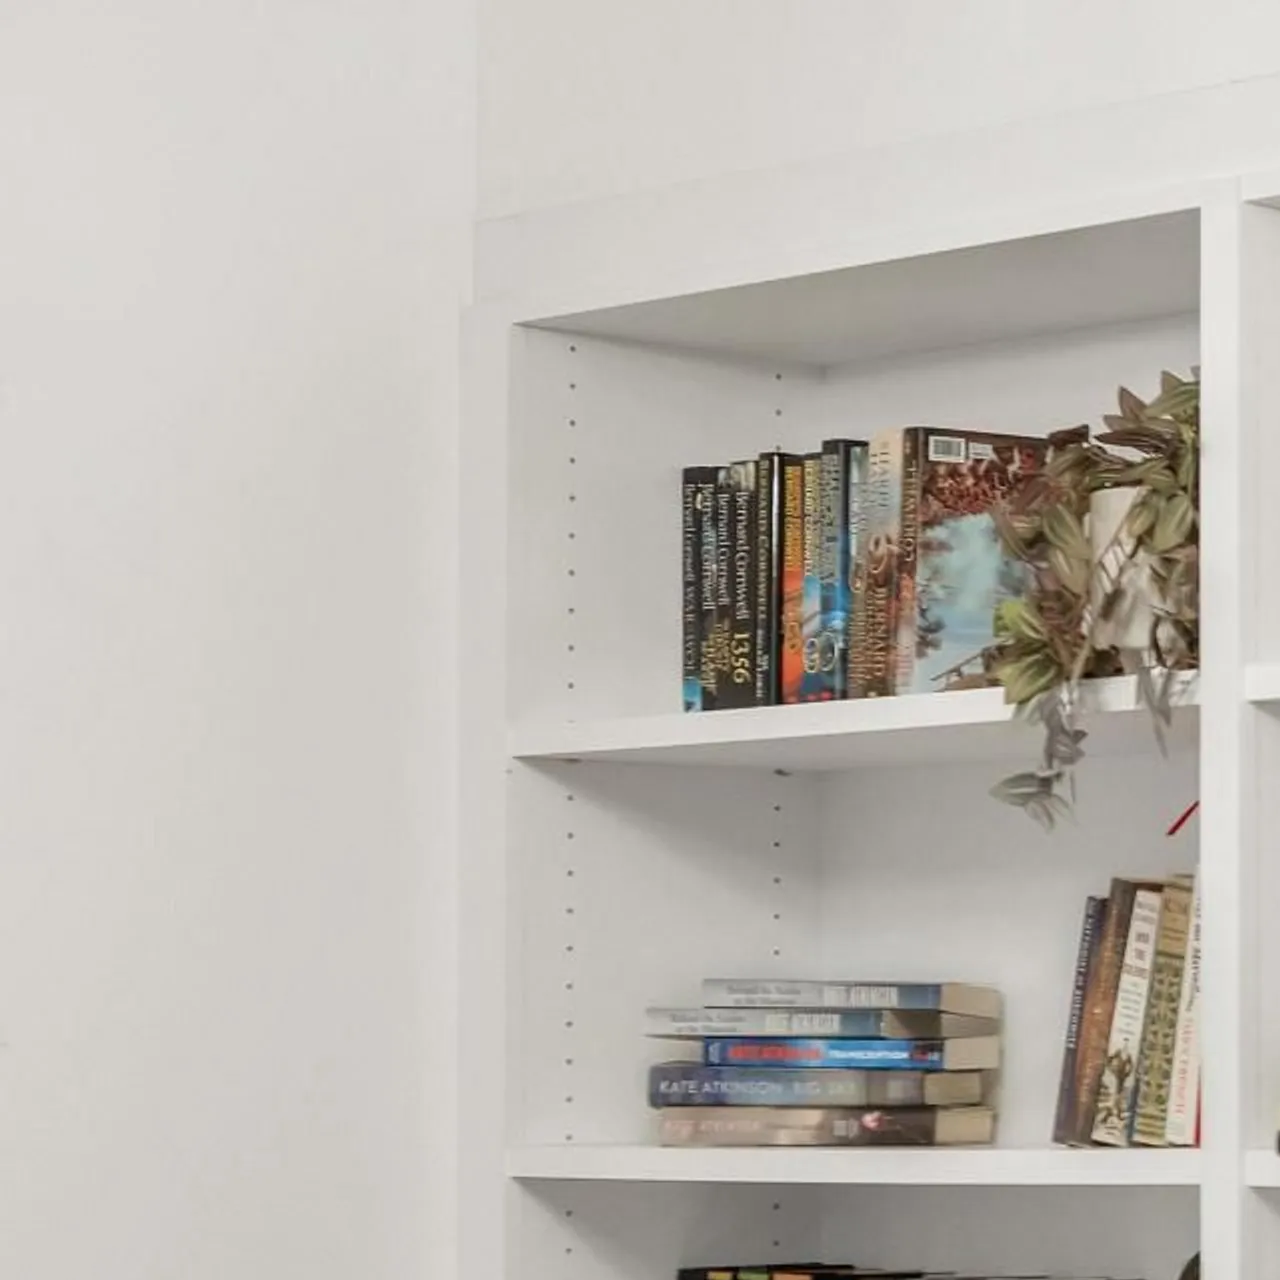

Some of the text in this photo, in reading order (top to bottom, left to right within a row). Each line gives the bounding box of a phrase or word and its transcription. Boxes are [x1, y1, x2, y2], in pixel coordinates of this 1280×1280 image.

[701, 547, 716, 610] Cornwell
[717, 492, 730, 605] Bernard Cornwell
[733, 492, 750, 684] Bernard Cornwell 1356
[659, 1080, 784, 1095] KATE ATKINSON
